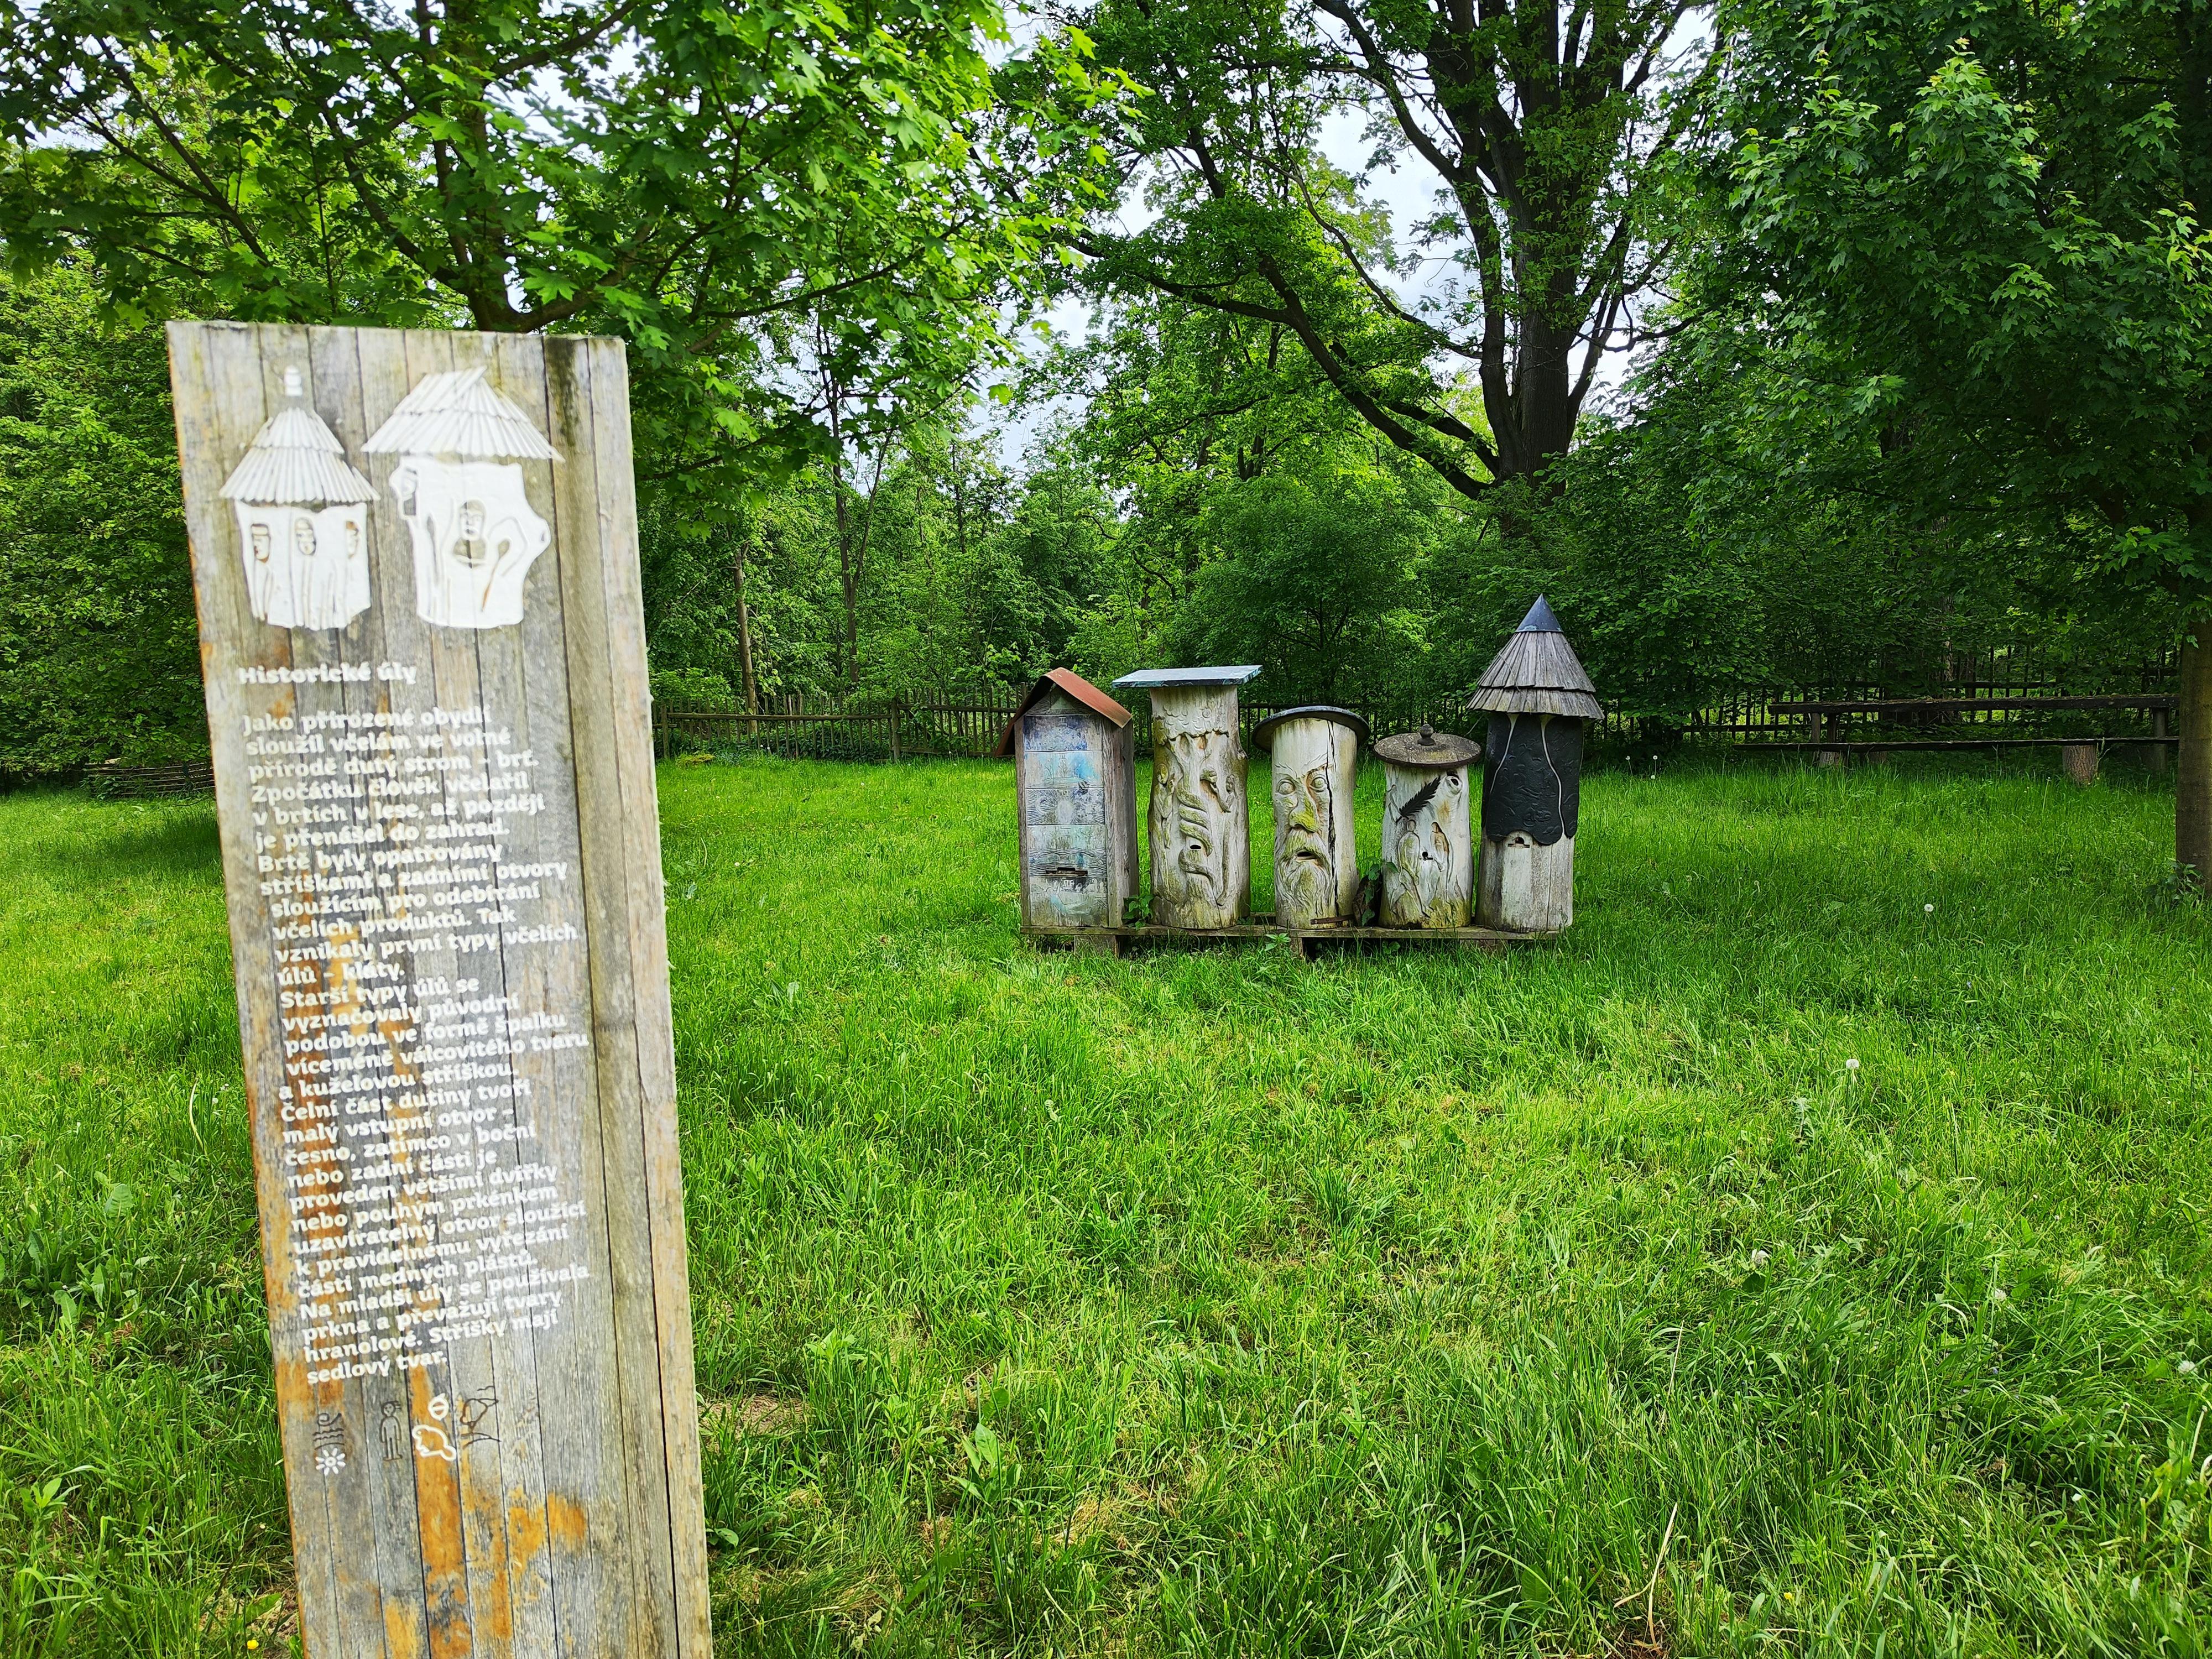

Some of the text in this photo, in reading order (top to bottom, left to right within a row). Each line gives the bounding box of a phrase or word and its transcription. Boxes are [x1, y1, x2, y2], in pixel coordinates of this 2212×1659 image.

[238, 660, 416, 685] Historické úly
[242, 713, 294, 737] Jako
[420, 704, 492, 729] obydlí
[247, 733, 325, 755] sloužil
[330, 731, 411, 752] včelám
[416, 734, 443, 747] ve
[248, 757, 337, 784] přírodě
[344, 754, 398, 778] dutý
[404, 755, 472, 773] strom
[252, 770, 529, 806] Zpočátku člověk včelařil
[252, 792, 545, 826] v brtích v lese, až později
[255, 817, 510, 854] je přenášel do zahrad.
[258, 852, 310, 873] Brtě
[316, 849, 367, 872] byly
[378, 873, 394, 888] a
[399, 863, 489, 886] zadními
[497, 862, 568, 880] otvory
[271, 894, 383, 917] sloužícím
[387, 892, 427, 913] pro
[273, 905, 517, 940] včelích produktů. Tak
[275, 922, 579, 963] vznikaly první typy včelích
[277, 966, 317, 985] úlů
[342, 960, 405, 981] kláty.
[280, 976, 479, 1009] Starší typy úlů se
[281, 992, 520, 1034] vyznačovaly původní
[284, 1011, 567, 1058] podobou ve formě špalku
[286, 1034, 589, 1076] víceméně válcovitého tvaru
[279, 1062, 519, 1100] a kuželovou stříškou.
[281, 1078, 531, 1122] Čelní část dutiny tvoří
[283, 1121, 338, 1144] malý
[345, 1112, 432, 1136] vstupní
[438, 1107, 497, 1126] otvor
[285, 1120, 537, 1166] česno, zatímco v boční
[287, 1149, 497, 1188] nebo zadní části je
[289, 1163, 557, 1215] proveden většími dvířky
[291, 1186, 558, 1233] nebo pouhým prkénkem
[442, 1215, 500, 1234] otvor
[507, 1199, 586, 1225] sloužící
[295, 1223, 569, 1277] k pravidelnému vyřezání
[299, 1275, 353, 1298] části
[300, 1262, 589, 1320] Na mladší úly se používala
[302, 1319, 371, 1345] prkna
[377, 1316, 390, 1330] a
[504, 1290, 561, 1310] tvary
[304, 1308, 559, 1363] hranolové. Stříšky mají
[307, 1350, 447, 1385] sedlový tvar.
